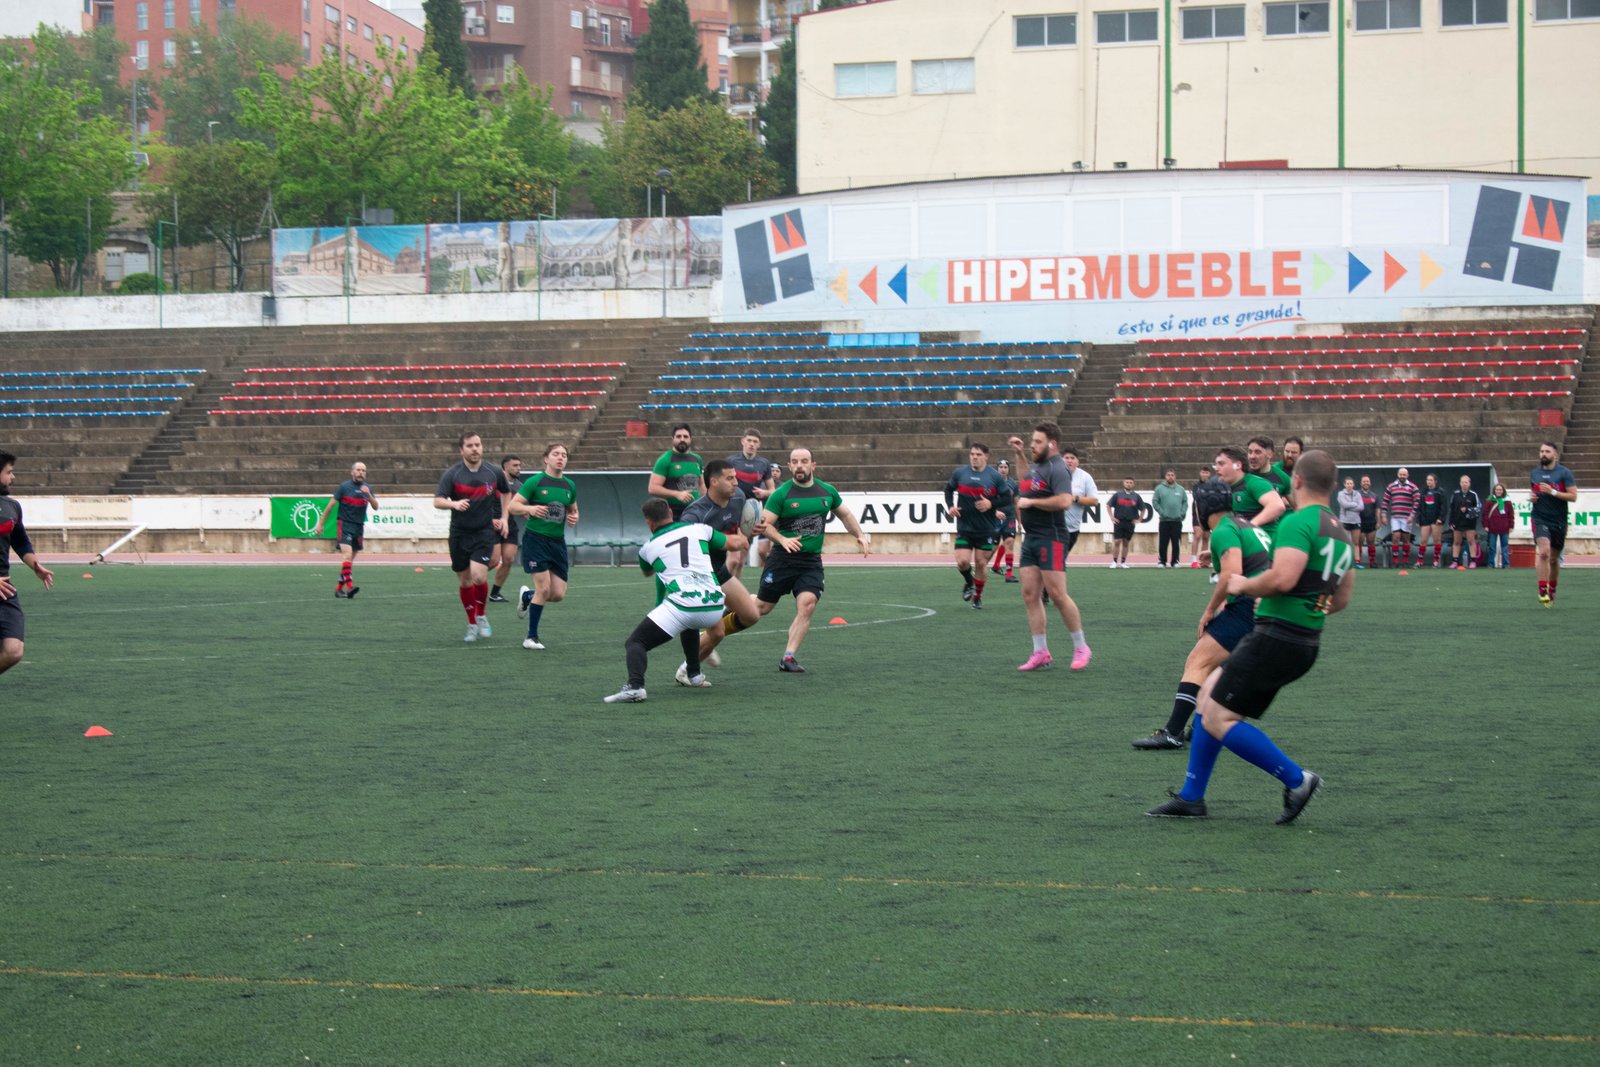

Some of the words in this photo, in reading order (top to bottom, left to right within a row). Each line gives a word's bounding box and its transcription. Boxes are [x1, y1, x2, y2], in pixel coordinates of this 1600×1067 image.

[952, 251, 1302, 303] HIPERMUEBLE
[1118, 319, 1154, 335] Esto
[1178, 315, 1208, 334] que
[1212, 314, 1230, 326] es
[665, 536, 689, 568] 7
[1319, 537, 1352, 585] 14
